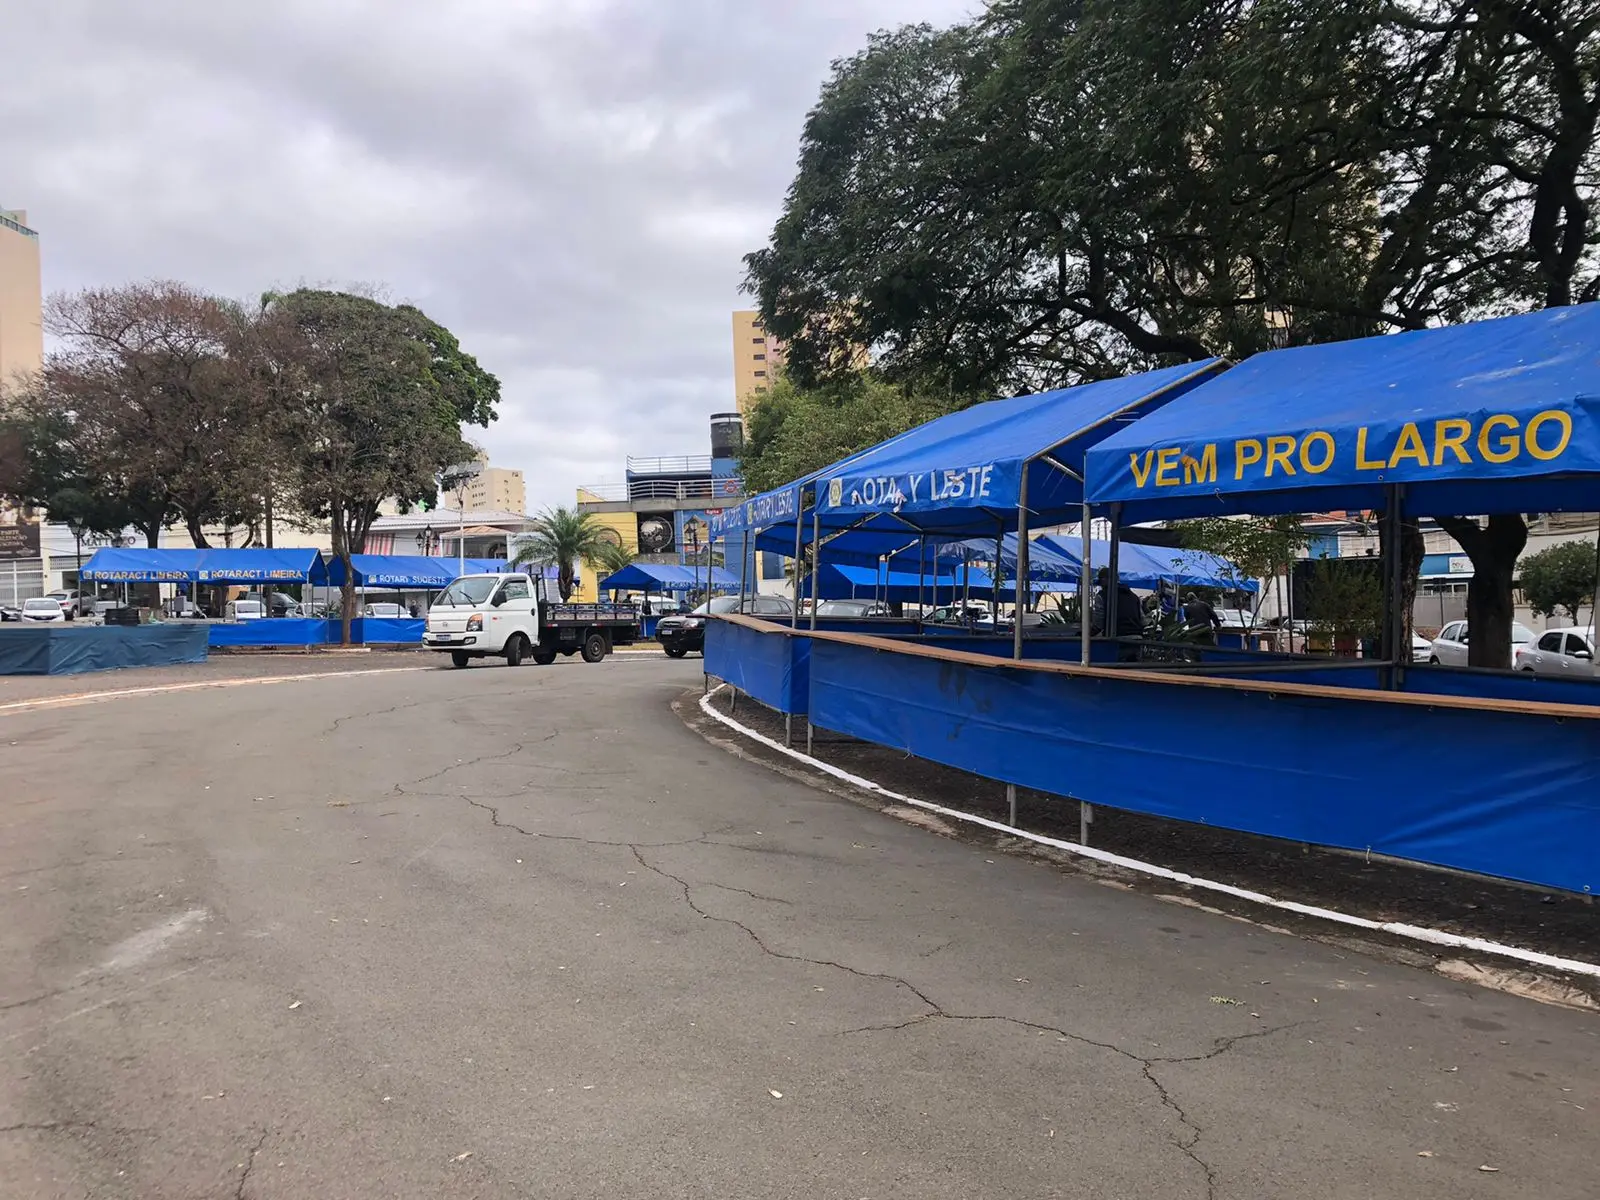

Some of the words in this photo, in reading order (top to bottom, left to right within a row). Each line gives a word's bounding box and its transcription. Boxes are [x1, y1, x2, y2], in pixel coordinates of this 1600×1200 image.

[1129, 443, 1217, 488] VEM
[1234, 431, 1336, 480] PRO
[1355, 409, 1573, 471] LARGO
[94, 571, 148, 580] ROTARACT
[211, 569, 260, 579] ROTARACT
[264, 569, 303, 579] LIMEIRA
[379, 575, 409, 583] ROTARY
